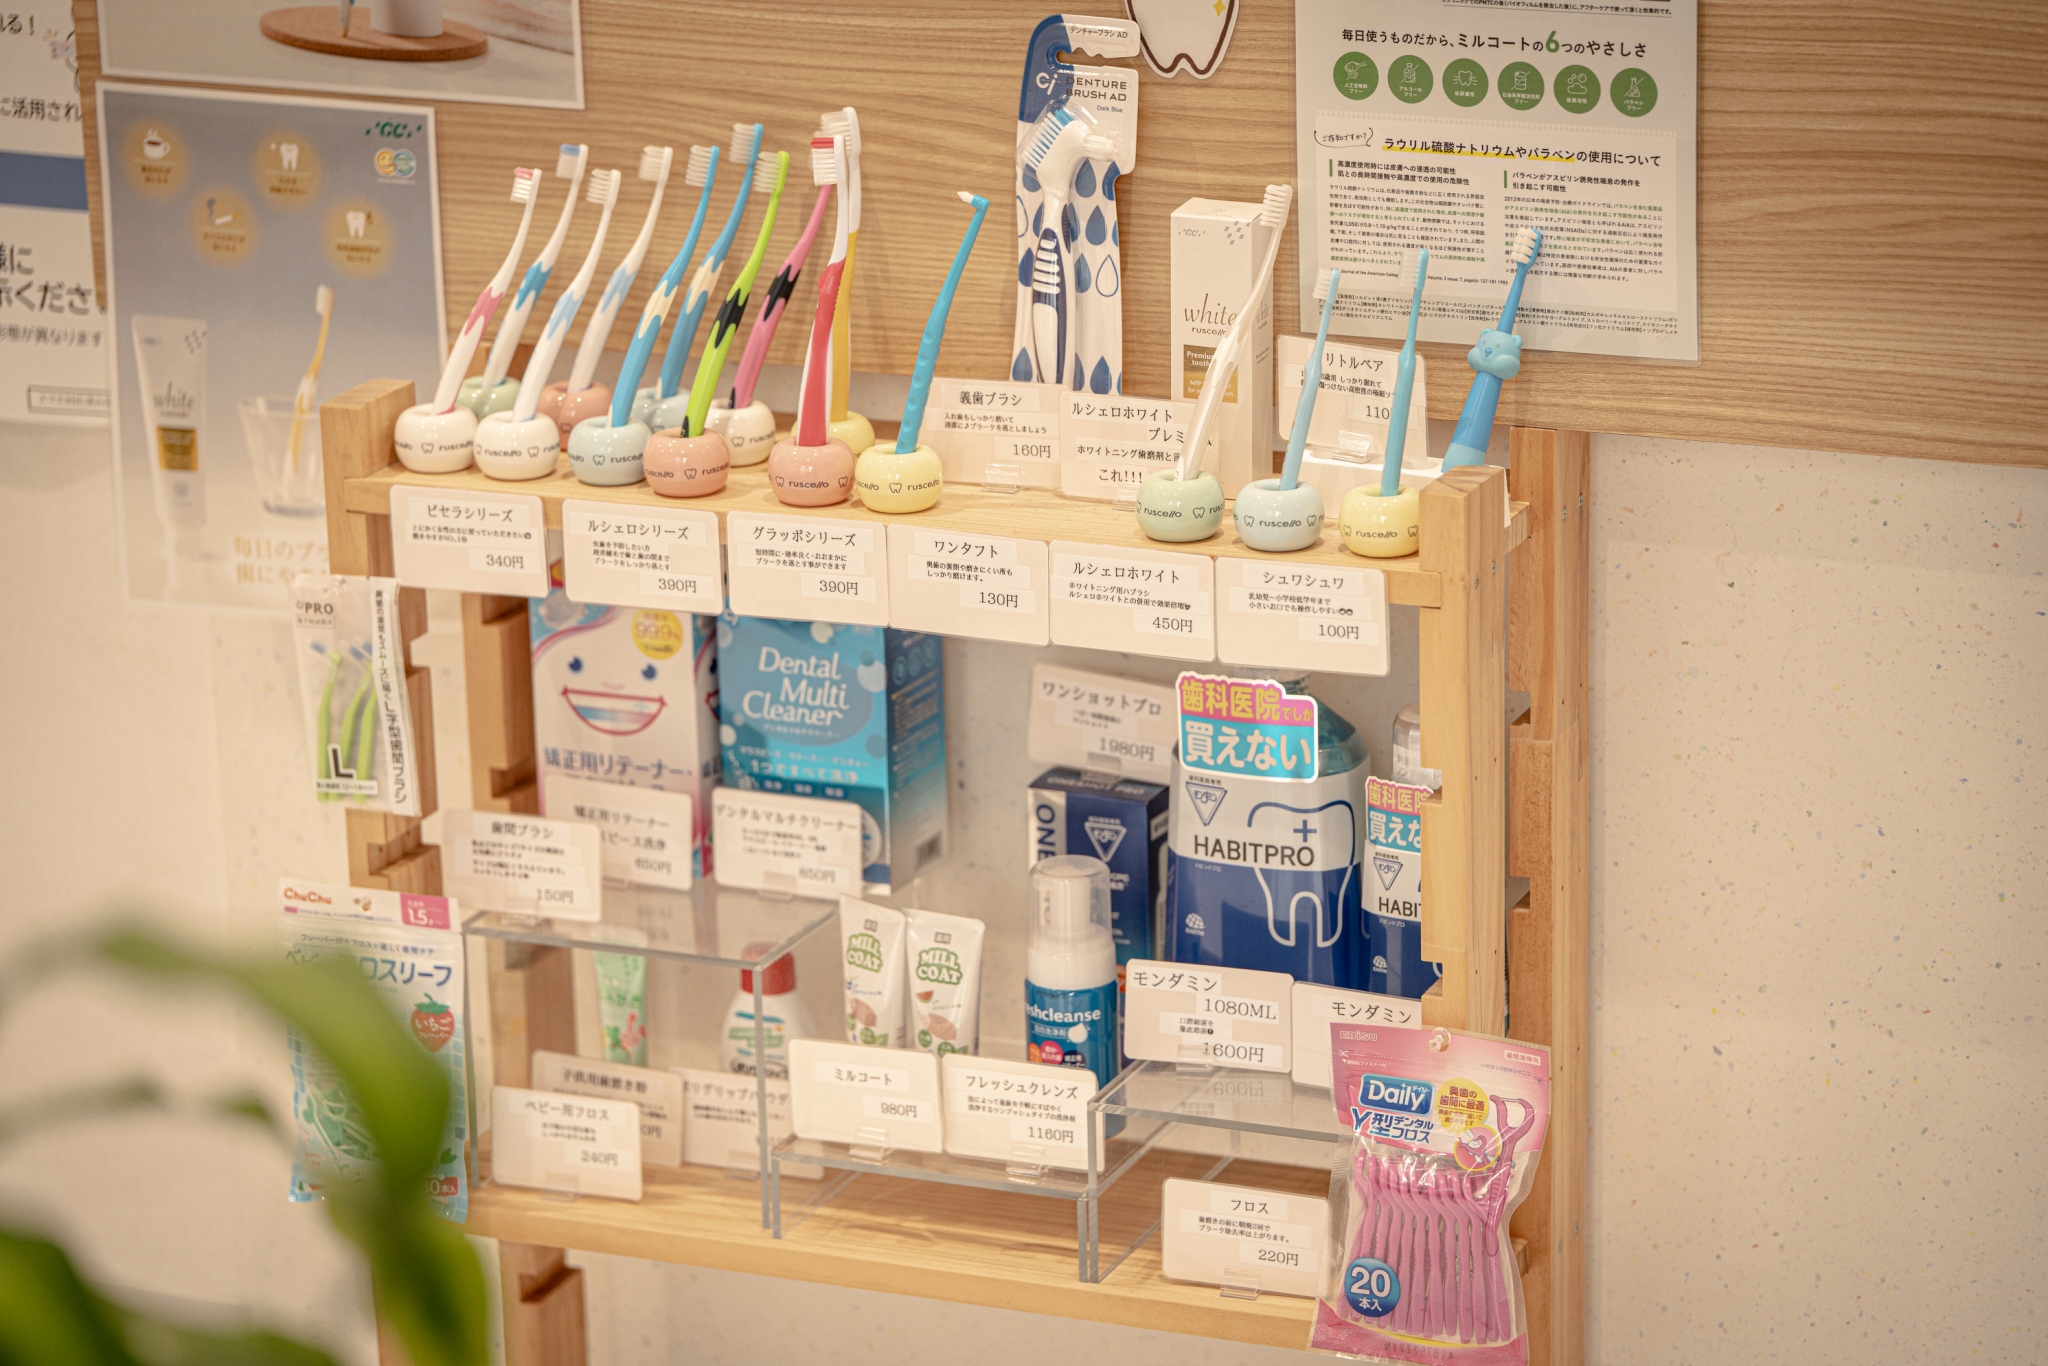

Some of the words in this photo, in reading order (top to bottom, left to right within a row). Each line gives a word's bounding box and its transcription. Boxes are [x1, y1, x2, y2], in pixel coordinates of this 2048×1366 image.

[1070, 26, 1115, 37] デンチャーブラシ
[1117, 31, 1128, 39] AD
[1342, 29, 1647, 58] 毎日使うものだから、ミルコートの6つのやさしさ
[1066, 77, 1127, 90] DENTURE
[1066, 88, 1107, 100] BRUSH
[1109, 92, 1127, 101] AD
[1384, 138, 1661, 167] ラウリル硫酸ナトリウムやパラベンの使用について
[1512, 182, 1567, 193] 引き起こす可能性
[1184, 293, 1238, 326] white
[1186, 350, 1213, 361] Premiu
[1325, 352, 1384, 372] リトルベア
[959, 391, 1022, 407] 義歯ブラシ
[1072, 402, 1173, 423] ルシェロホワイト
[1365, 405, 1392, 420] 110
[484, 448, 522, 458] ruscello
[610, 452, 643, 464] ruscell
[1012, 444, 1051, 459] 160円
[788, 480, 829, 490] ruscello
[907, 479, 940, 491] ruscello
[1144, 508, 1182, 519] ruscello
[587, 520, 689, 540] ルシェロシリーズ
[1259, 520, 1302, 528] ruscello
[752, 526, 857, 547] グラッポシリーズ
[1355, 531, 1398, 539] ruscello
[934, 540, 998, 558] ワンタフト
[486, 554, 524, 569] 340円
[1073, 561, 1179, 585] ルシェロホワイト
[1262, 571, 1345, 590] シュワシュワ
[658, 578, 697, 594] 390円
[819, 580, 859, 596] 390円
[979, 591, 1019, 609] 130円
[1152, 616, 1193, 634] 450円
[1318, 624, 1360, 640] 100円
[758, 646, 842, 680] Dental
[780, 676, 850, 710] Multi
[1181, 679, 1313, 723] 歯科医院でしか
[742, 690, 844, 727] Cleaner
[1185, 719, 1311, 771] 買えない
[1194, 834, 1315, 868] HABITPRO
[920, 950, 959, 970] MILL
[917, 965, 962, 985] COAT
[1132, 970, 1218, 993] モンダミン
[1203, 998, 1277, 1021] 1080ML
[1331, 1001, 1412, 1024] モンダミン
[1202, 1042, 1264, 1063] 1600円
[834, 1067, 893, 1086] ミルコート
[966, 1075, 1079, 1100] フレッシュクレンズ
[1367, 1079, 1426, 1111] Daily
[1449, 1085, 1478, 1098] 奥歯の
[880, 1102, 918, 1119] 980円
[1439, 1094, 1485, 1112] 歯間に最適
[1028, 1126, 1075, 1145] 1160円
[1230, 1199, 1270, 1215] フロス
[1258, 1249, 1300, 1267] 220円
[1350, 1266, 1391, 1298] 20
[1358, 1296, 1383, 1312] 本入
